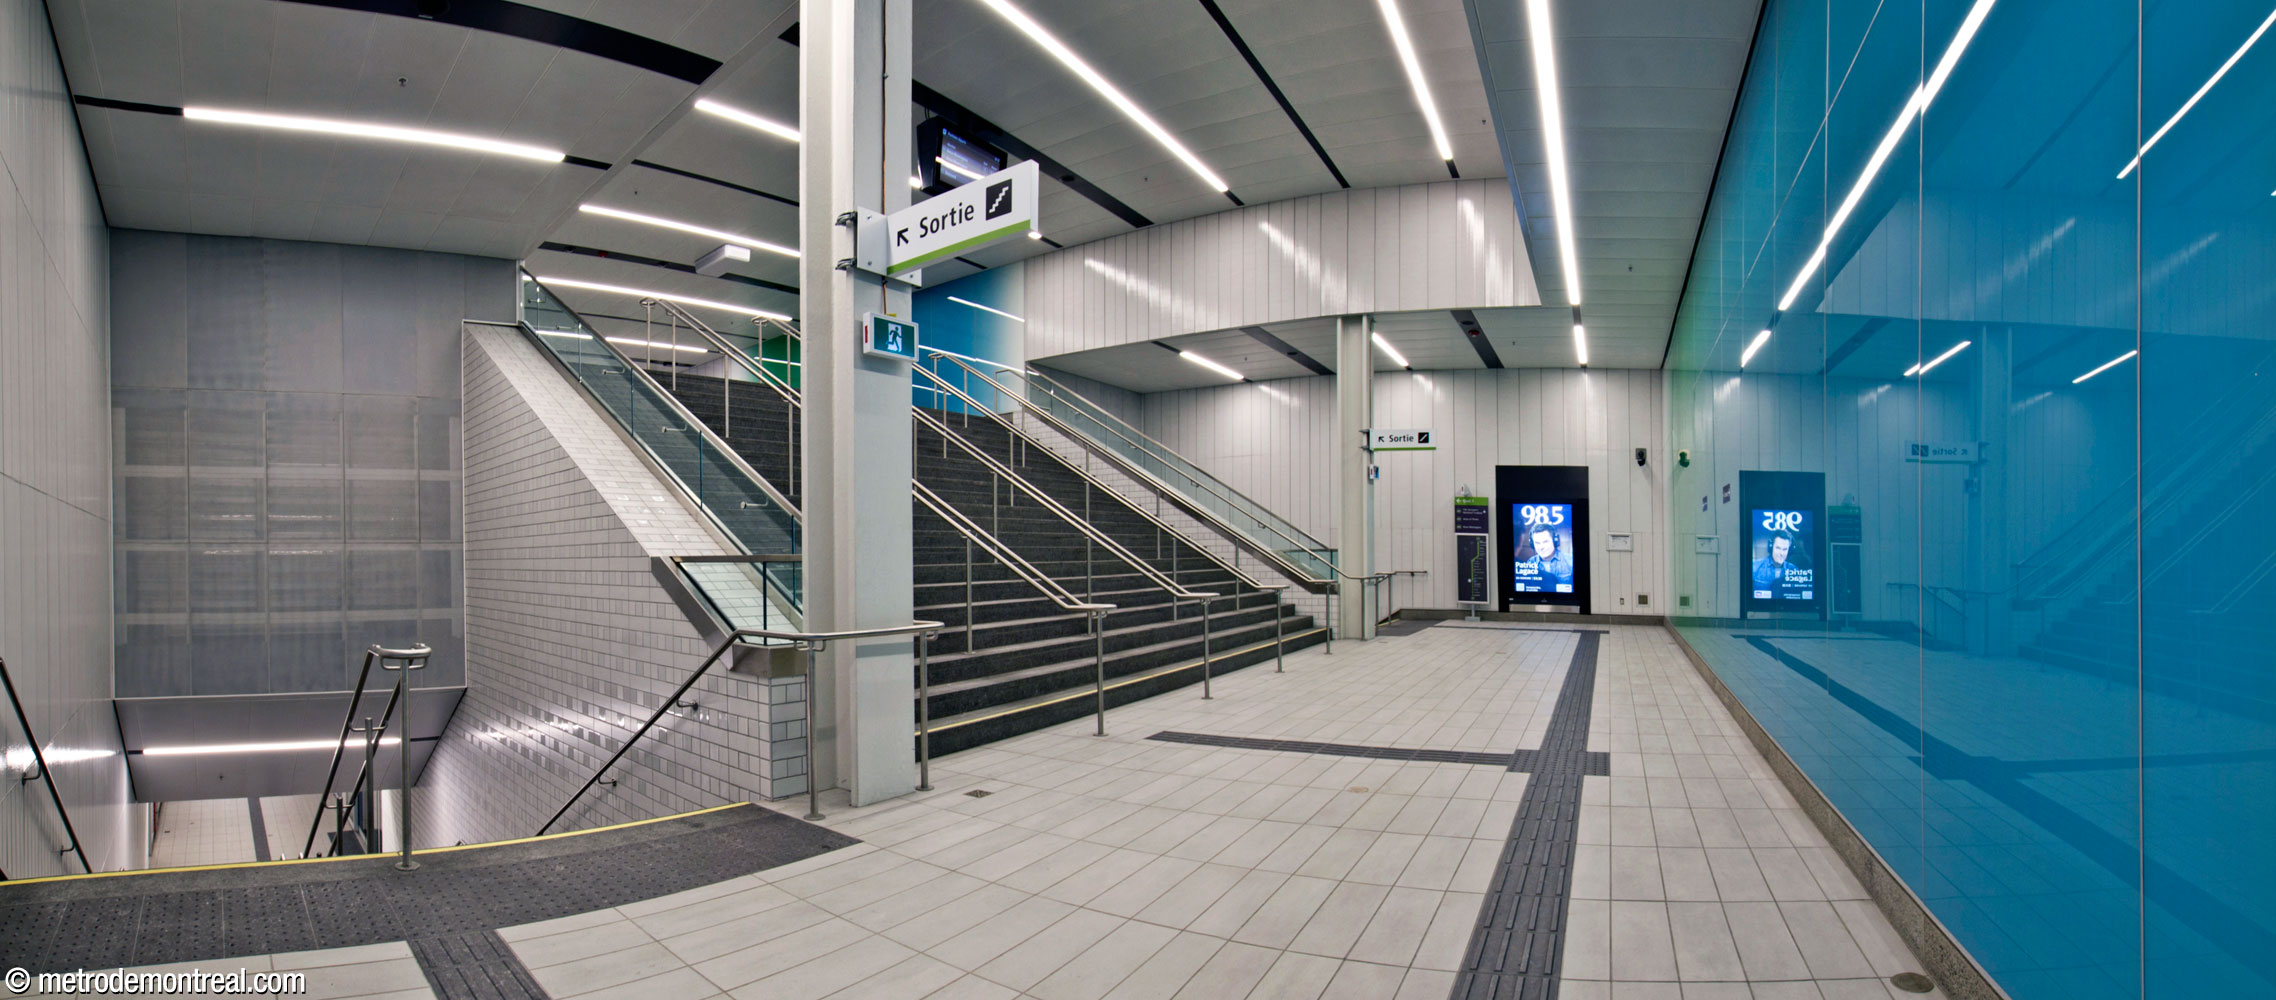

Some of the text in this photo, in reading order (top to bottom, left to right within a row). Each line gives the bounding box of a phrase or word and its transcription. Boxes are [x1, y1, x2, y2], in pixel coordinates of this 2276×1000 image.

[919, 201, 975, 239] Sortie
[1389, 434, 1414, 443] Sortie
[1520, 504, 1565, 526] 98.5
[1515, 561, 1539, 569] Patrick
